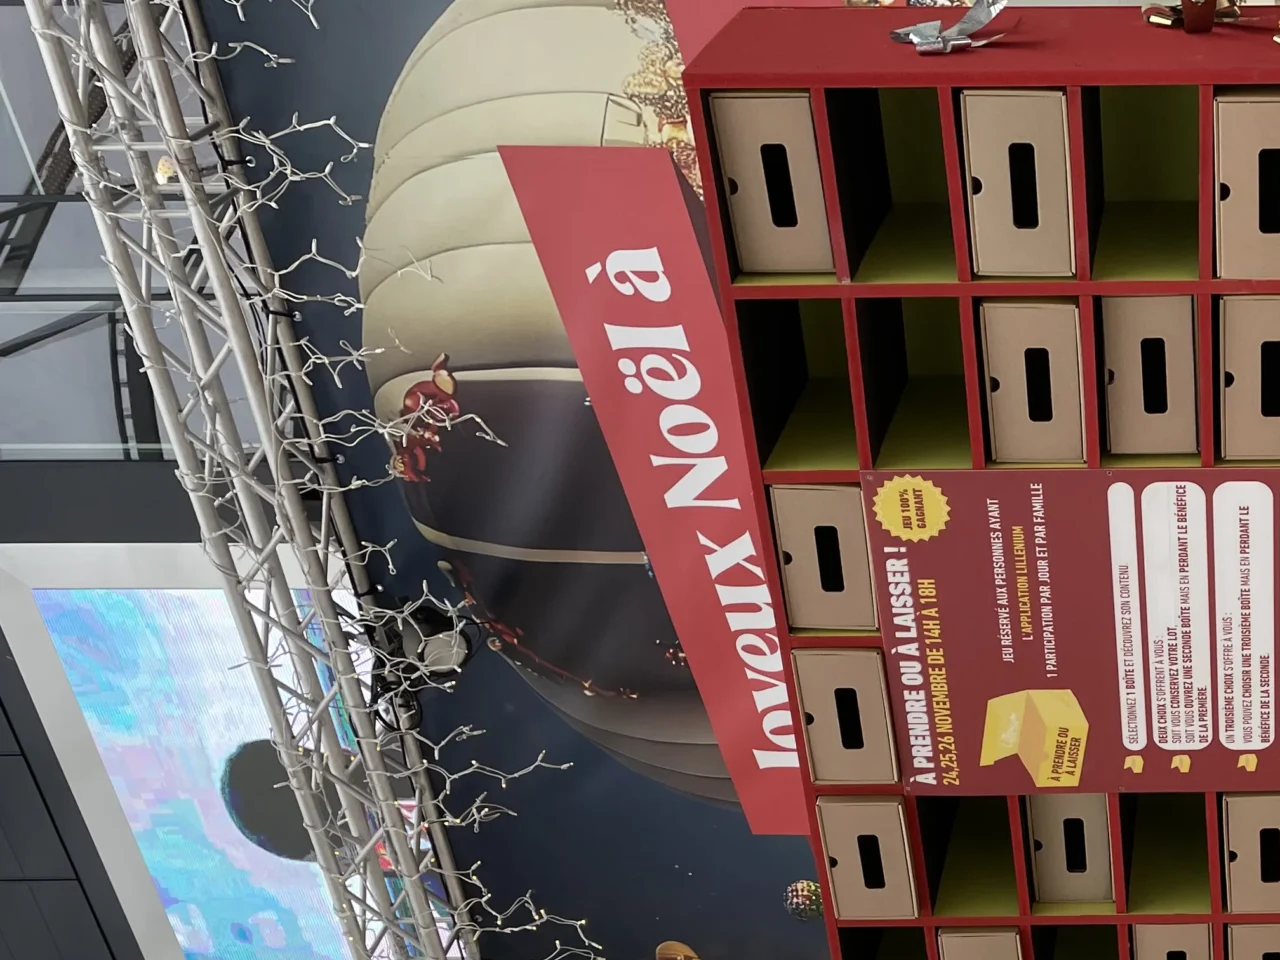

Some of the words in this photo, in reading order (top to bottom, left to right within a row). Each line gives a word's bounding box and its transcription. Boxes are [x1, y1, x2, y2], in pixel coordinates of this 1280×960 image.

[585, 247, 672, 302] à
[604, 322, 742, 510] Noël
[899, 488, 911, 514] 100%
[912, 488, 927, 529] GAGNANT
[1030, 483, 1045, 522] FAMILLE
[1174, 484, 1188, 522] BÉNÉFICE
[1239, 506, 1249, 516] LE
[901, 516, 914, 530] JEU
[987, 498, 1002, 529] AYANT
[1034, 525, 1047, 544] PAR
[1177, 525, 1188, 534] LE
[1239, 518, 1250, 554] PERDANT
[990, 532, 1007, 584] PERSONNES
[1012, 526, 1028, 574] LILLENIUM
[1036, 546, 1048, 557] ET
[1178, 536, 1189, 572] PERDANT
[1240, 556, 1250, 566] EN
[1036, 560, 1050, 582] JOUR
[1180, 575, 1190, 584] EN
[1240, 568, 1250, 586] MAIS
[886, 558, 918, 638] LAISSER
[918, 578, 938, 604] 18H
[996, 587, 1008, 605] AUX
[1038, 586, 1052, 603] PAR
[1180, 586, 1190, 604] MAIS
[1238, 588, 1250, 610] BOÎTE
[916, 608, 940, 617] À
[1016, 576, 1034, 640] L'APPLICATION
[1120, 600, 1132, 615] SON
[1178, 606, 1191, 628] BOÎTE
[922, 620, 942, 644] 14H
[994, 607, 1012, 645] RÉSERVÉ
[1120, 617, 1134, 656] DÉCOUVREZ
[1222, 616, 1232, 635] VOUS
[1238, 612, 1252, 651] TROISIÈME
[891, 642, 920, 656] À
[1040, 606, 1058, 670] PARTICIPATION
[1154, 640, 1164, 658] VOUS
[1181, 630, 1192, 663] SECONDE
[926, 648, 945, 664] DE
[1002, 648, 1015, 663] JEU
[1168, 643, 1178, 666] VOTRE
[1222, 644, 1234, 671] S'OFFRE
[1242, 653, 1252, 668] UNE
[899, 661, 924, 686] OU
[1122, 668, 1136, 690] BOÎTE
[1182, 665, 1193, 680] UNE
[1224, 673, 1234, 694] CHOIX
[1154, 666, 1166, 702] S'OFFRENT
[1168, 668, 1180, 708] CONSERVEZ
[1183, 682, 1194, 708] OUVREZ
[1242, 670, 1252, 698] CHOISIR
[1260, 690, 1270, 698] LA
[928, 667, 954, 733] NOVEMBRE
[1260, 700, 1270, 709] DE
[1126, 698, 1138, 744] SÉLECTIONNEZ
[1156, 704, 1168, 724] CHOIX
[1170, 710, 1181, 728] VOUS
[1184, 710, 1194, 728] VOUS
[1222, 696, 1234, 732] TROISIÈME
[1242, 700, 1252, 724] POUVEZ
[903, 689, 935, 768] PRENDRE
[1058, 727, 1070, 738] OU
[1158, 726, 1168, 744] DEUX
[1172, 730, 1182, 744] SOIT
[1185, 730, 1195, 744] SOIT
[1198, 724, 1208, 732] LA
[1242, 726, 1252, 744] VOUS
[1258, 710, 1270, 743] BÉNÉFICE
[1198, 734, 1208, 743] DE
[1225, 734, 1235, 744] UN
[937, 736, 960, 786] 24,25,26
[1051, 739, 1068, 774] PRENDRE
[1066, 737, 1082, 768] LAISSER
[910, 772, 937, 785] À
